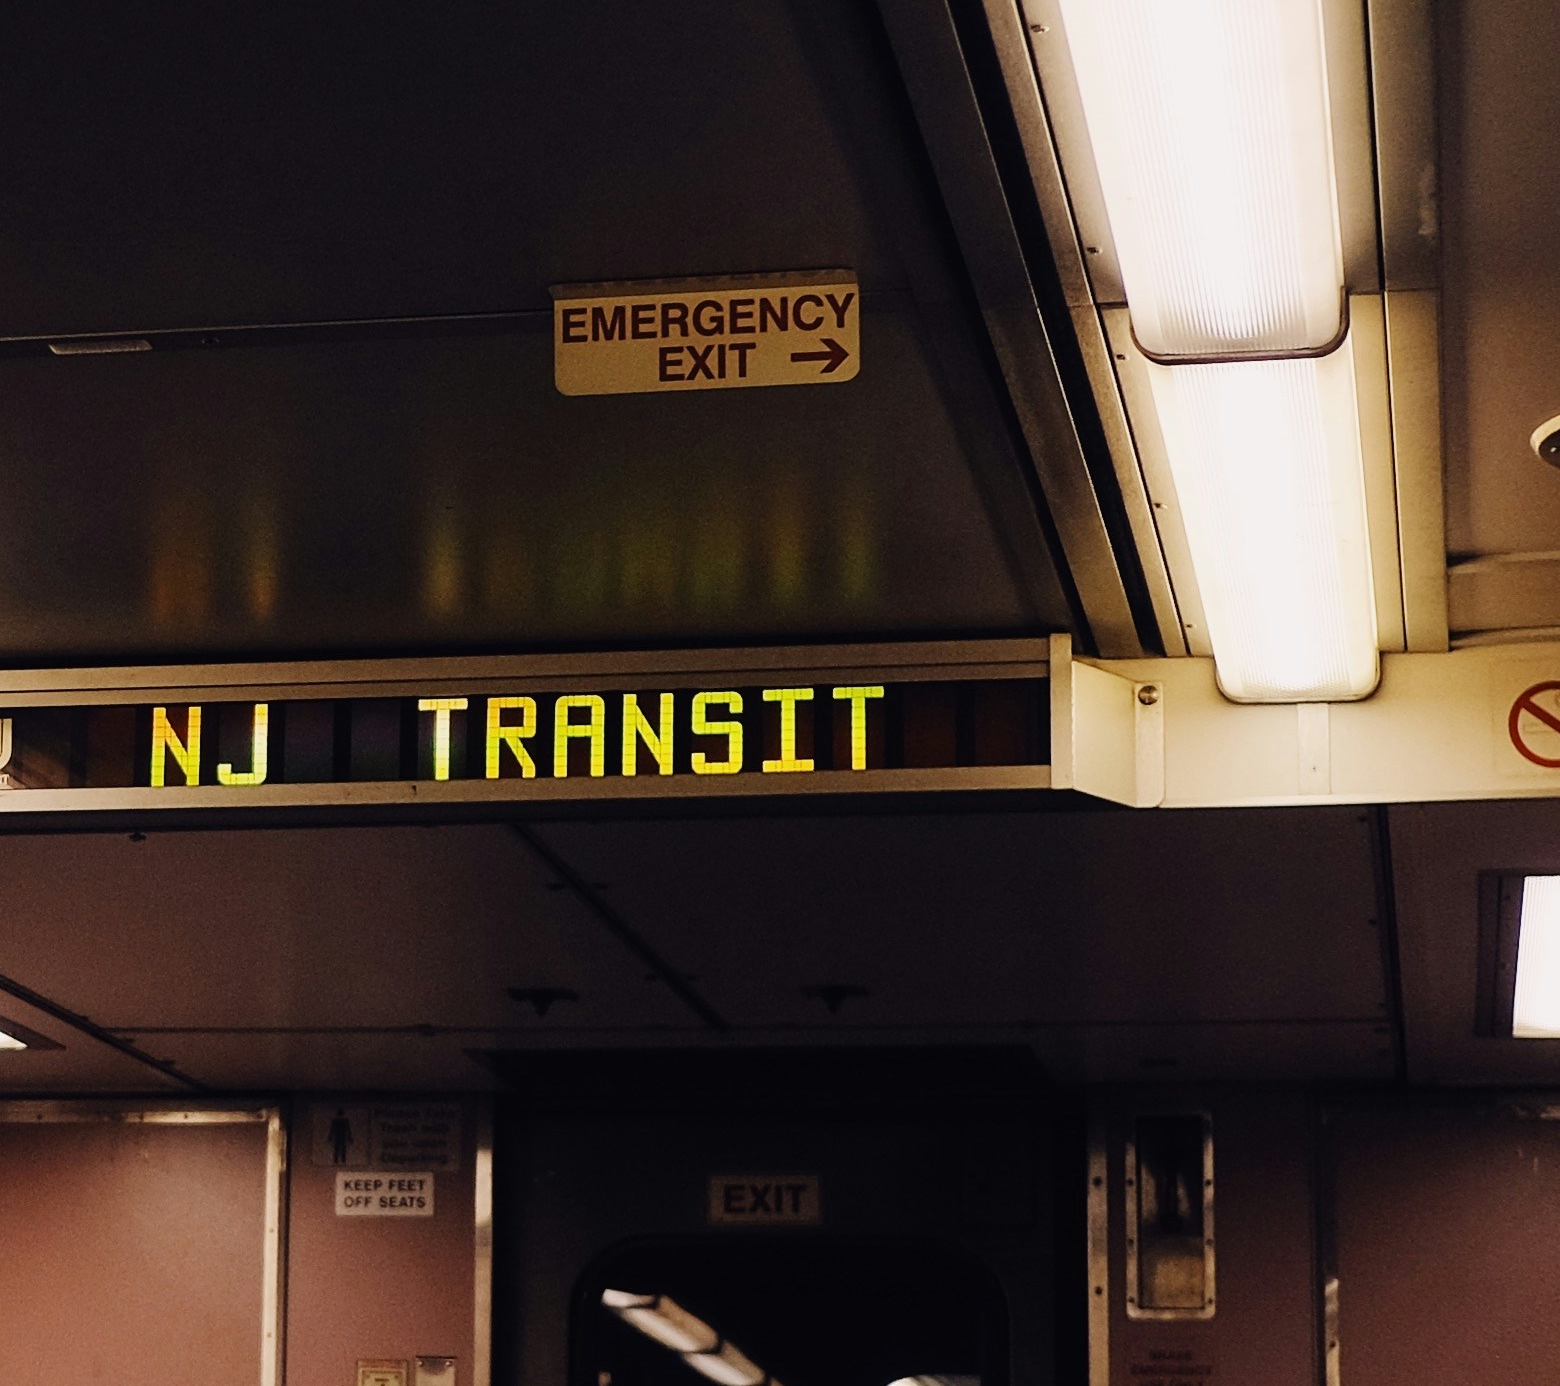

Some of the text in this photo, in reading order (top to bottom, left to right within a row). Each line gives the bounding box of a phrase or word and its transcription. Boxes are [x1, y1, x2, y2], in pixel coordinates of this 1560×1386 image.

[562, 293, 854, 343] EMERGENCY
[659, 343, 756, 382] EXIT
[151, 686, 884, 787] NJ TRANSIT
[344, 1179, 425, 1191] KEEP FEET
[724, 1184, 806, 1212] EXIT
[344, 1196, 425, 1208] OFF SEATS
